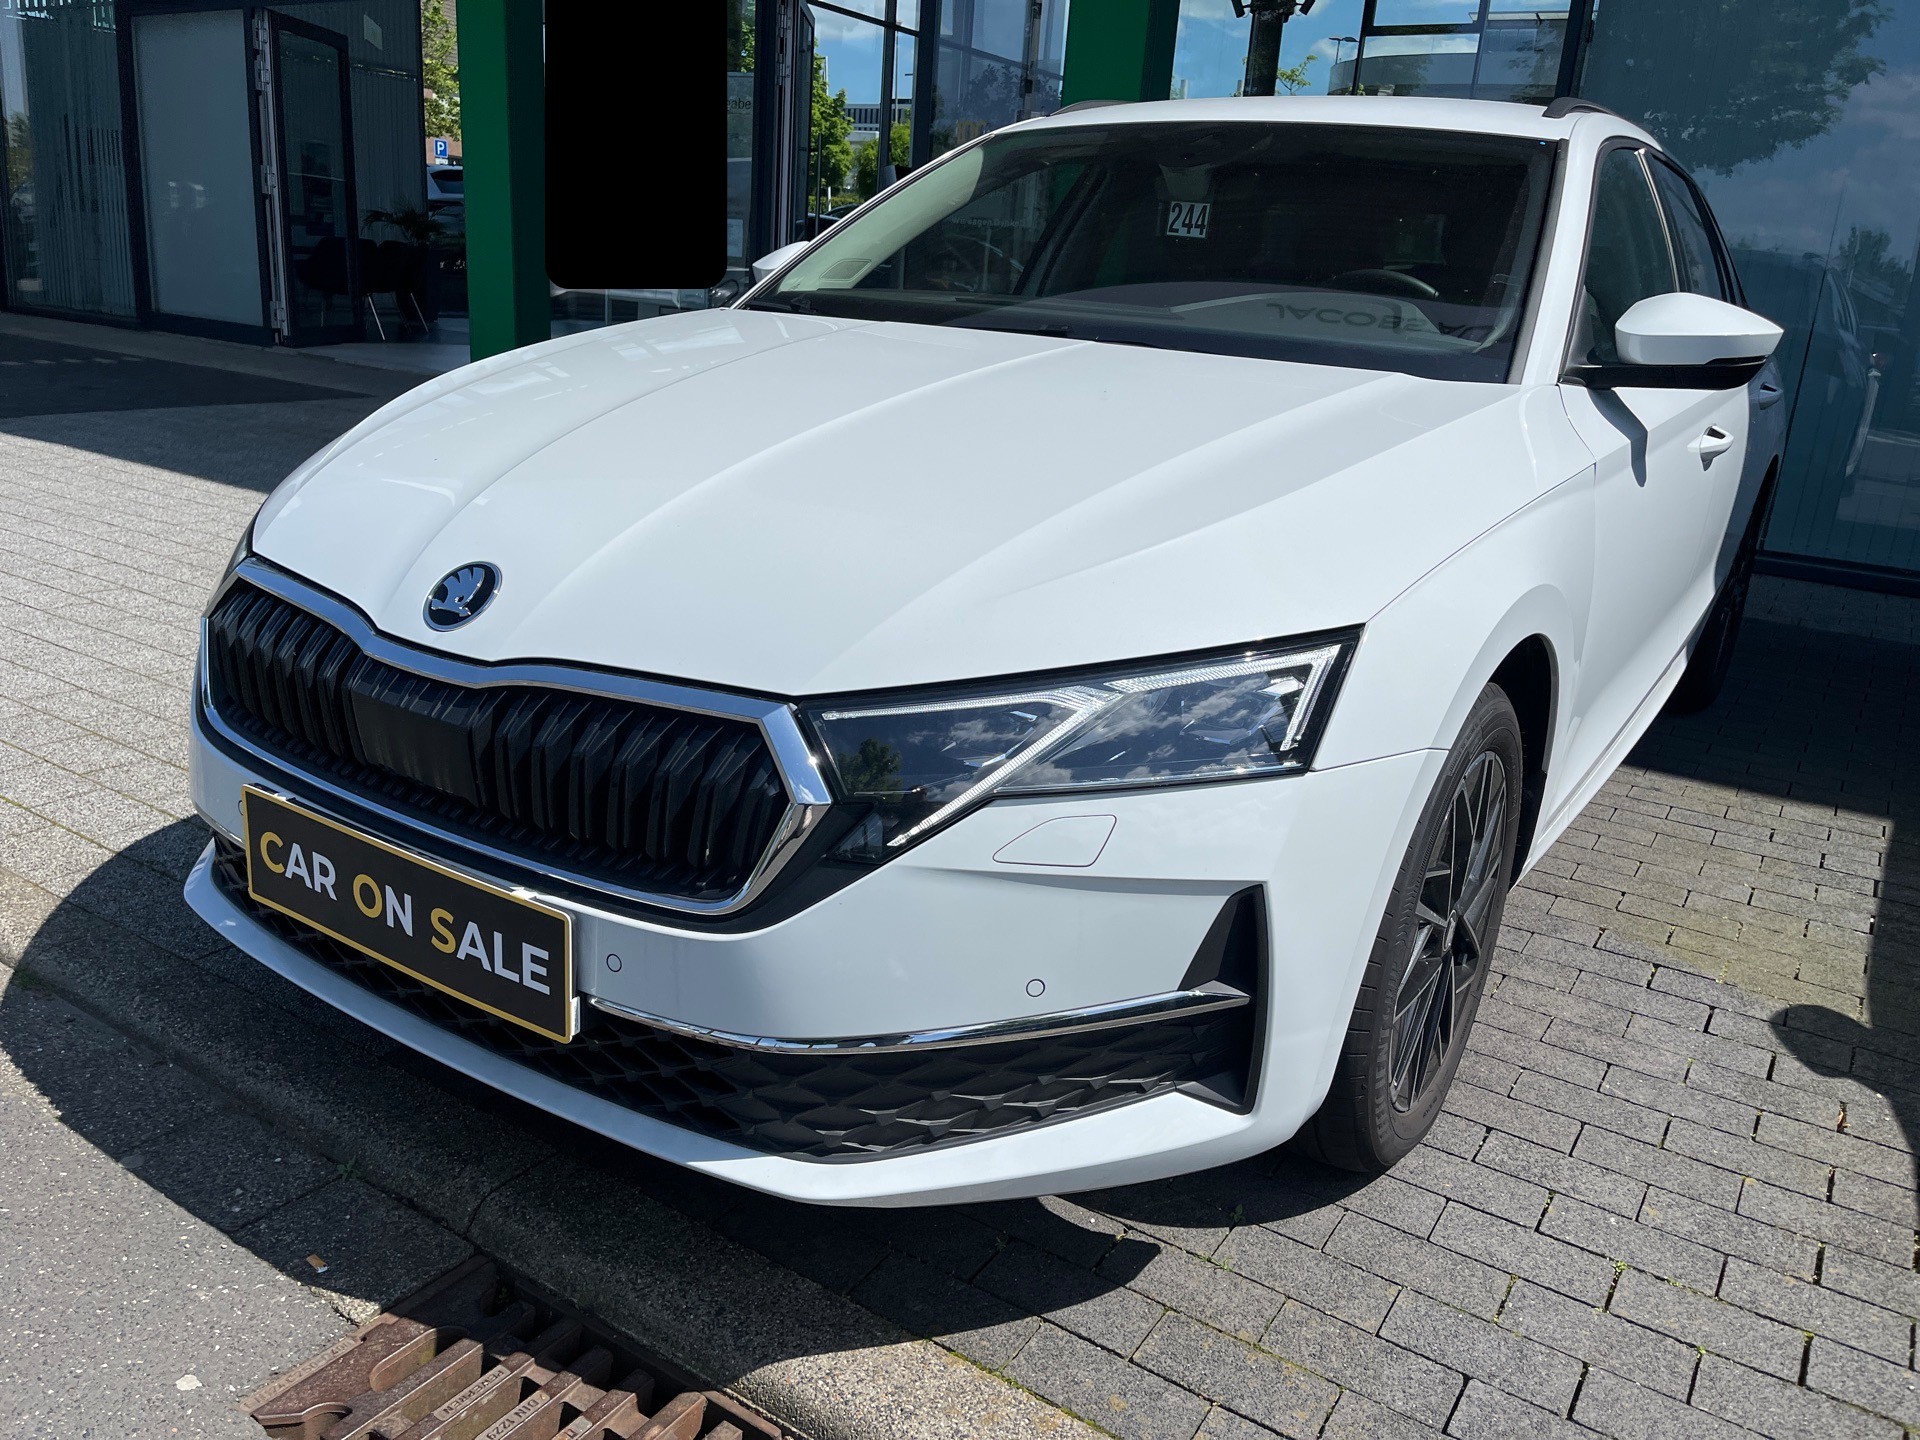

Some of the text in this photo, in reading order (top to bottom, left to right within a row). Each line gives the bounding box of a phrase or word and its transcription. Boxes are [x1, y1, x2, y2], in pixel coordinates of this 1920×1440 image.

[438, 141, 444, 154] P
[1168, 202, 1208, 236] 244
[260, 831, 551, 996] CAR ON SALE
[486, 1399, 540, 1440] DIN 1229
